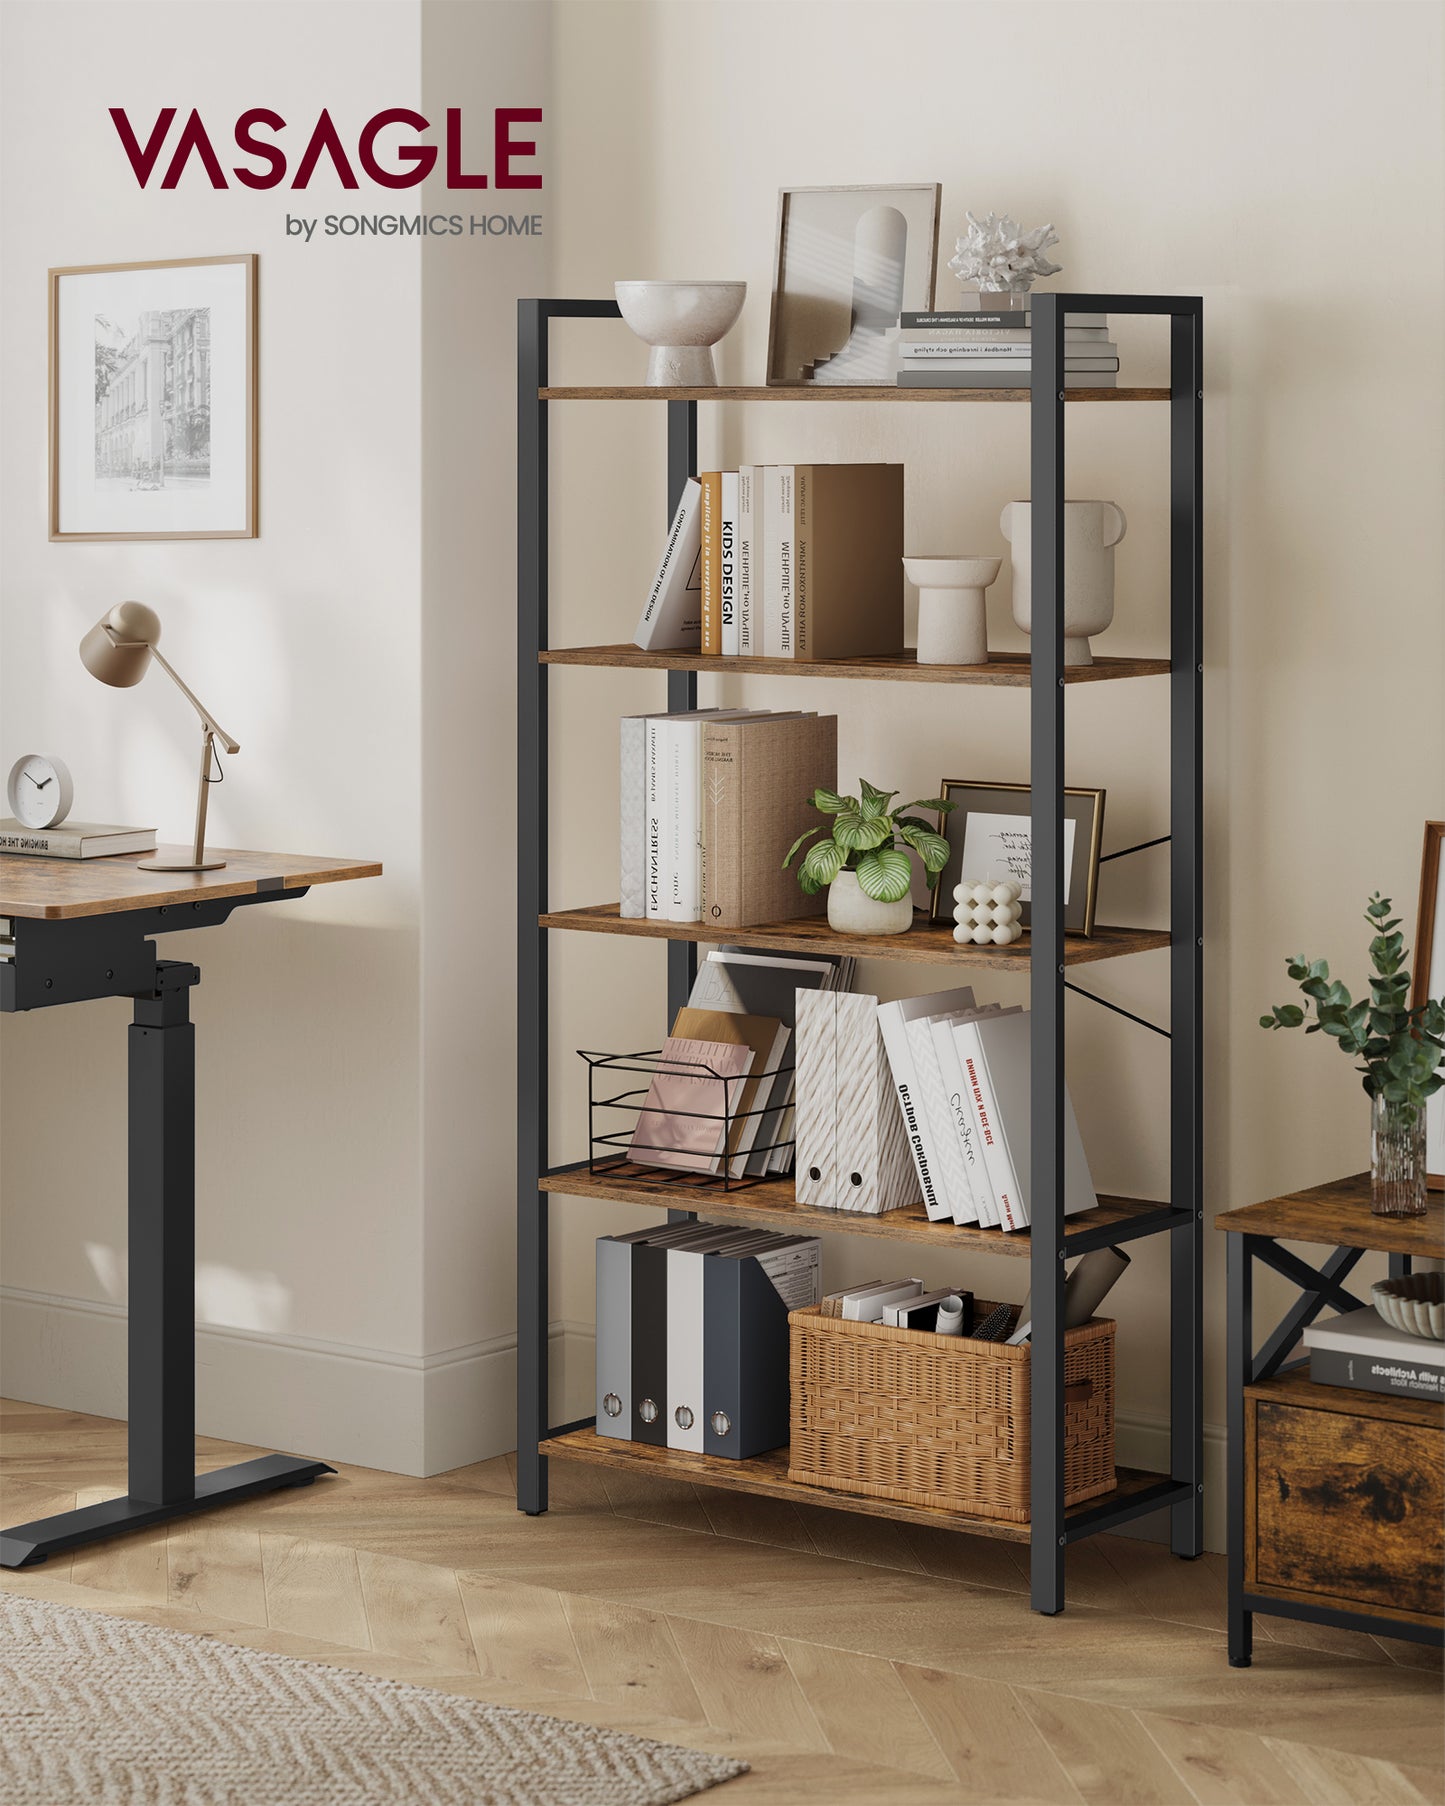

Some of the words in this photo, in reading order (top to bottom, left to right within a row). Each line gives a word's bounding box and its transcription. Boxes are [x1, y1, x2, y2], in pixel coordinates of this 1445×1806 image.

[662, 509, 686, 569] CONTAMINATION
[722, 521, 733, 559] KIDS
[704, 547, 711, 556] in
[659, 568, 667, 580] OF
[653, 580, 663, 595] THE
[722, 563, 733, 625] DESIGN
[644, 594, 658, 622] DESIGN
[704, 614, 710, 628] we
